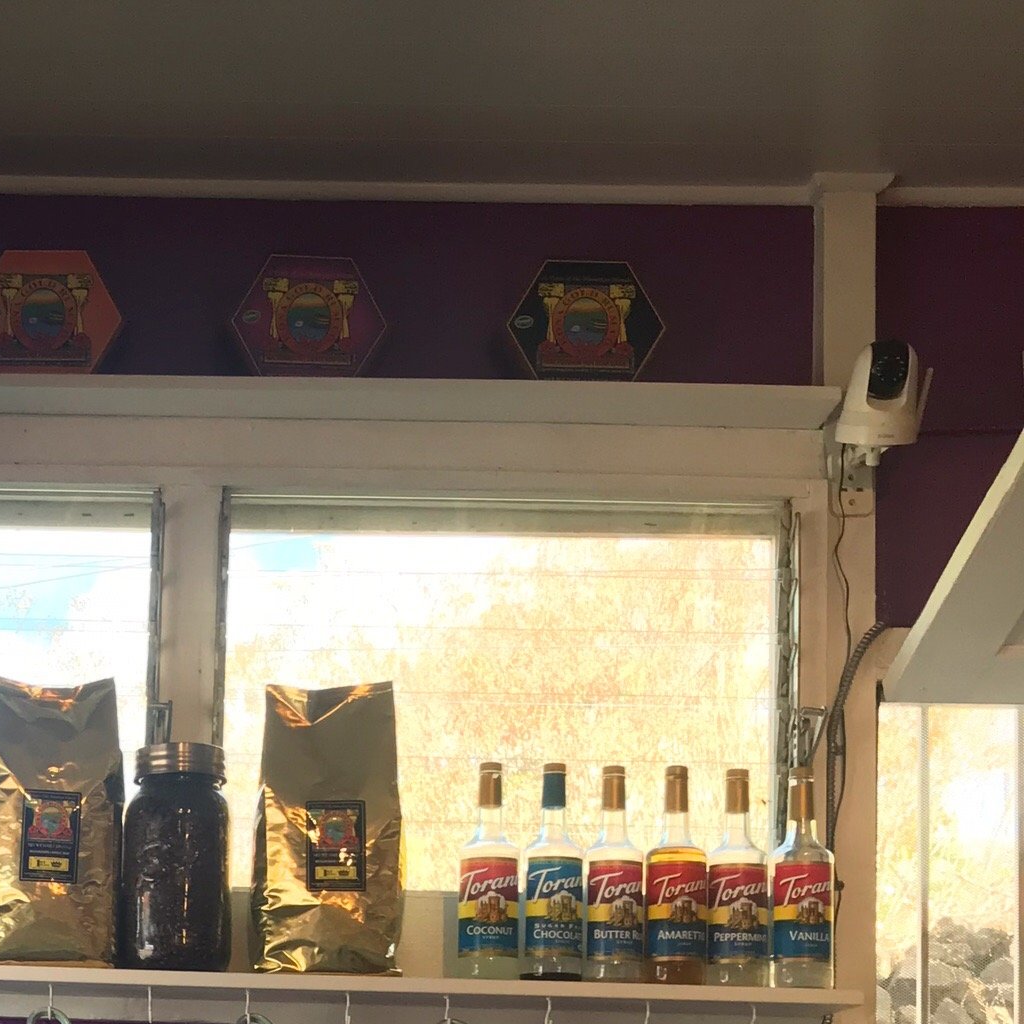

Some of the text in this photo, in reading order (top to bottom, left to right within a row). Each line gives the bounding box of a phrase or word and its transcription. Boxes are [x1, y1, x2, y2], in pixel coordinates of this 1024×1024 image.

[528, 866, 583, 903] Toran
[779, 873, 832, 907] Toran
[711, 872, 767, 910] Toran
[466, 925, 513, 936] COCONUT
[594, 929, 631, 940] BUTTER
[789, 930, 830, 942] VANILLA
[713, 931, 767, 943] PEPPERMIN
